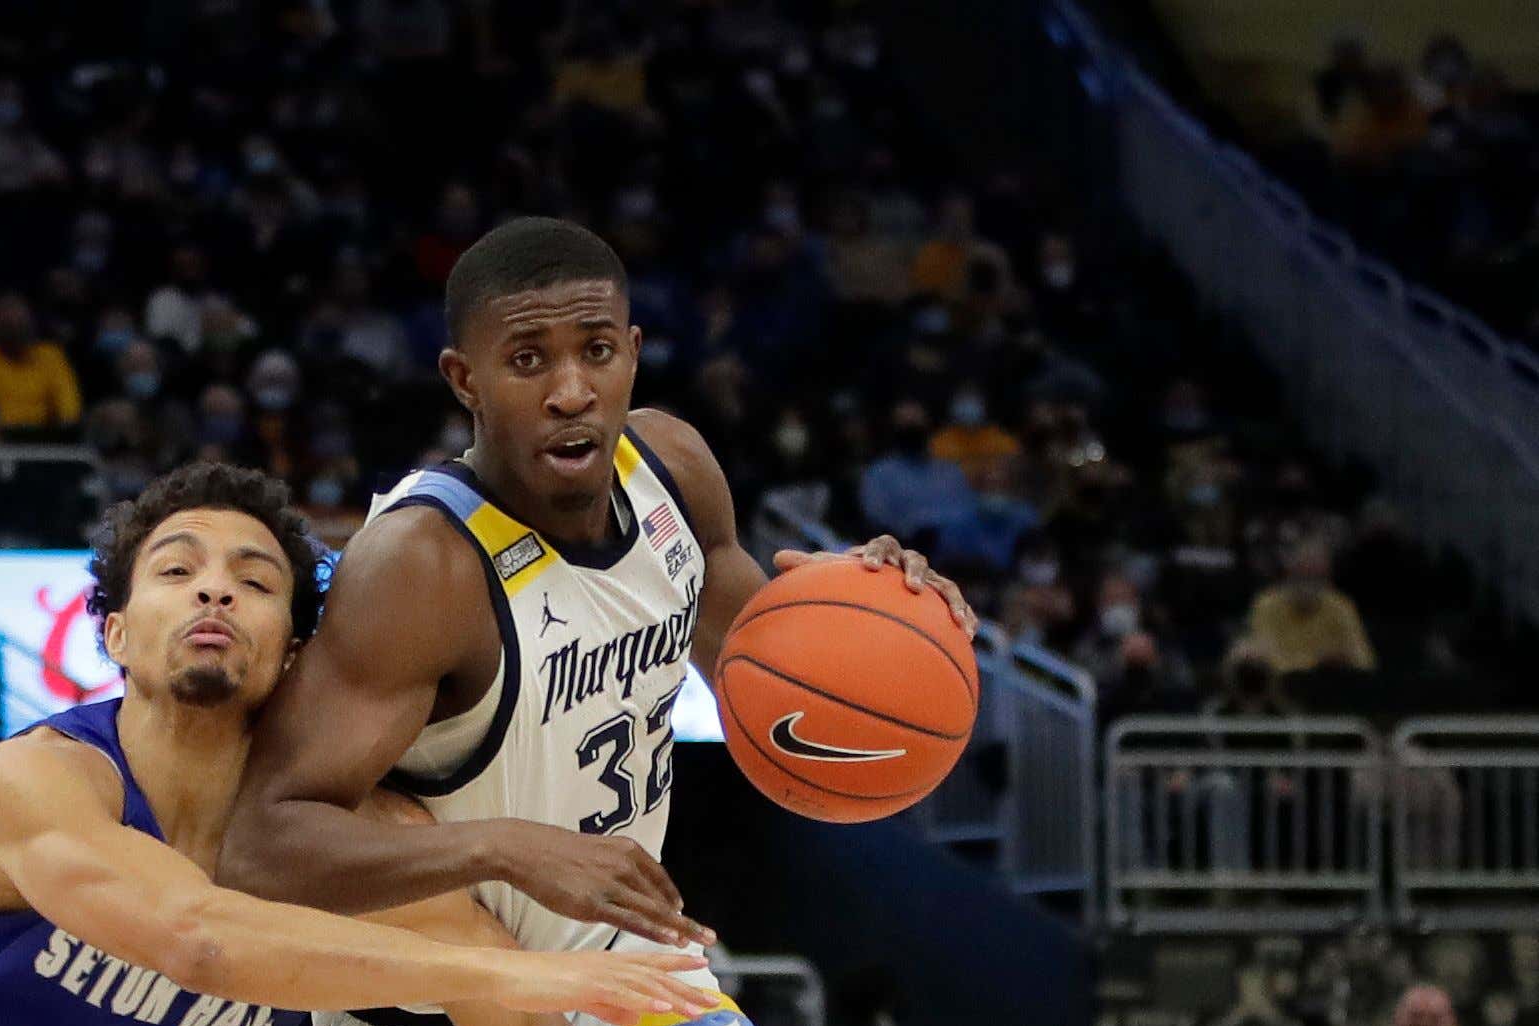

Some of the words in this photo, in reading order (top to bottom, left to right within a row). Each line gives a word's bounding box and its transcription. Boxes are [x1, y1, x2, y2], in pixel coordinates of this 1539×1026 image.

[539, 574, 697, 725] Marquett
[575, 676, 687, 837] 32
[34, 928, 182, 1025] SETON
